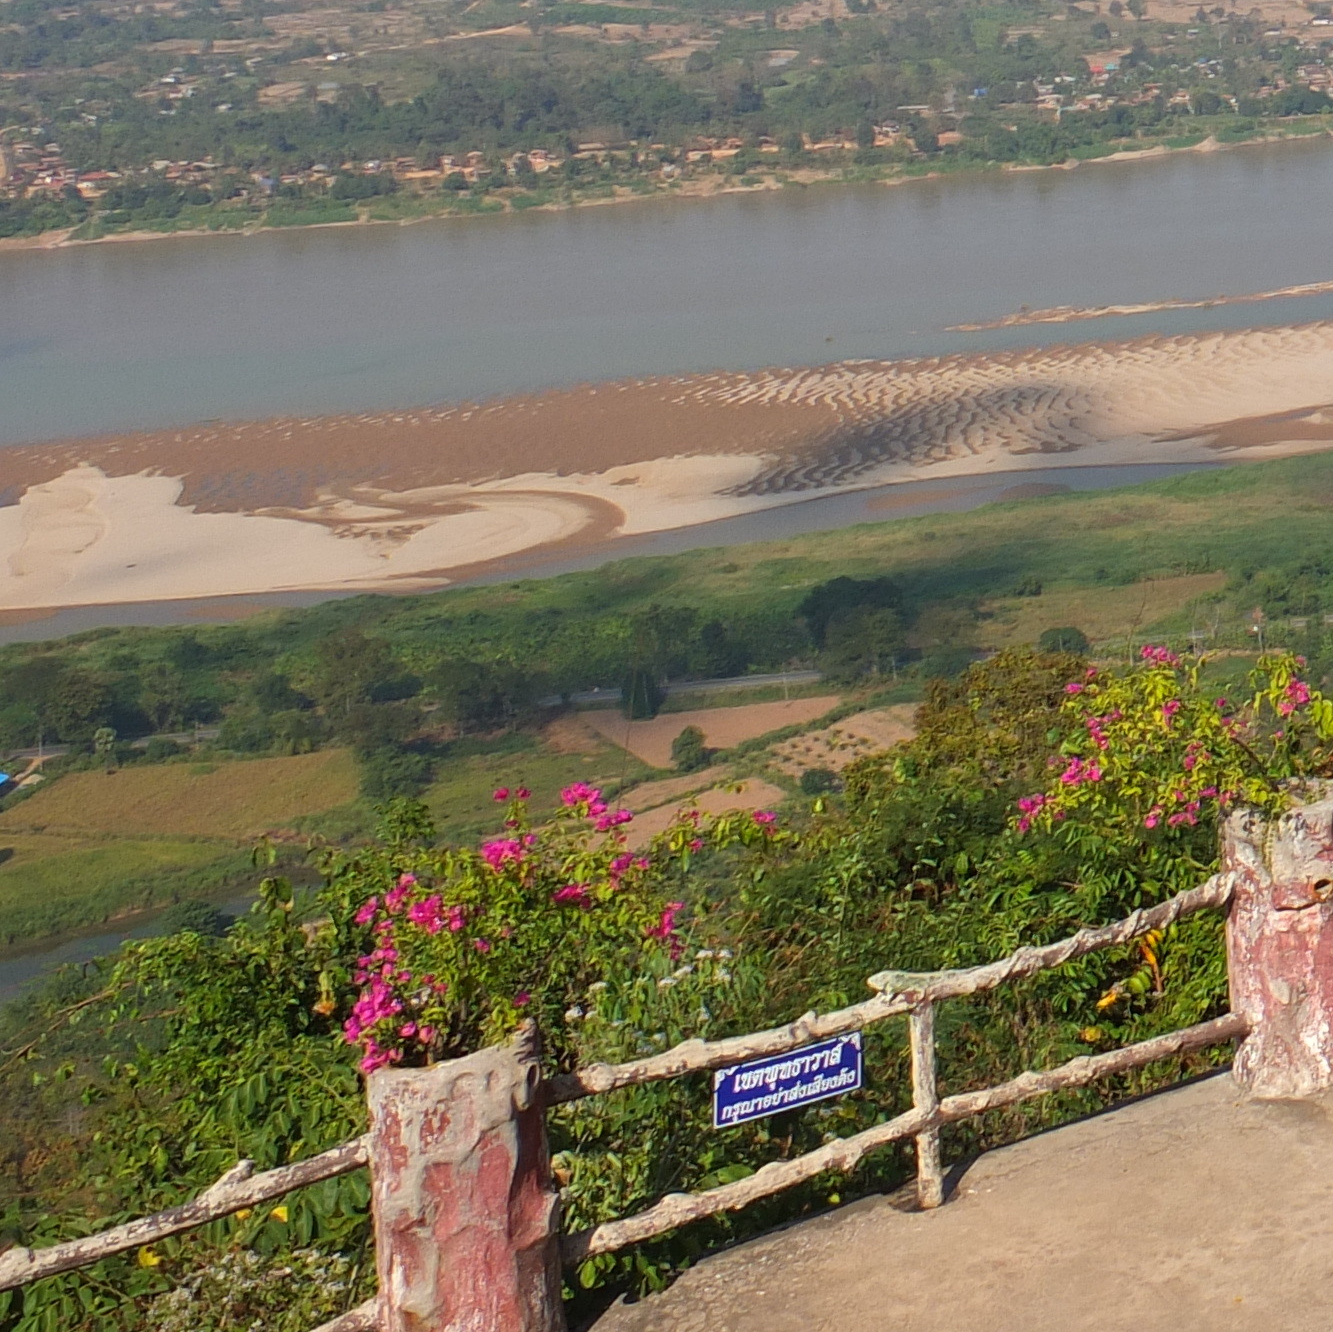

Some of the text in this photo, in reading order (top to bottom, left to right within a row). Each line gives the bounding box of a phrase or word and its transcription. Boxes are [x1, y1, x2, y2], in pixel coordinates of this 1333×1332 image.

[722, 1068, 856, 1121] กรุณาอย่าส่งเสียงดัง
